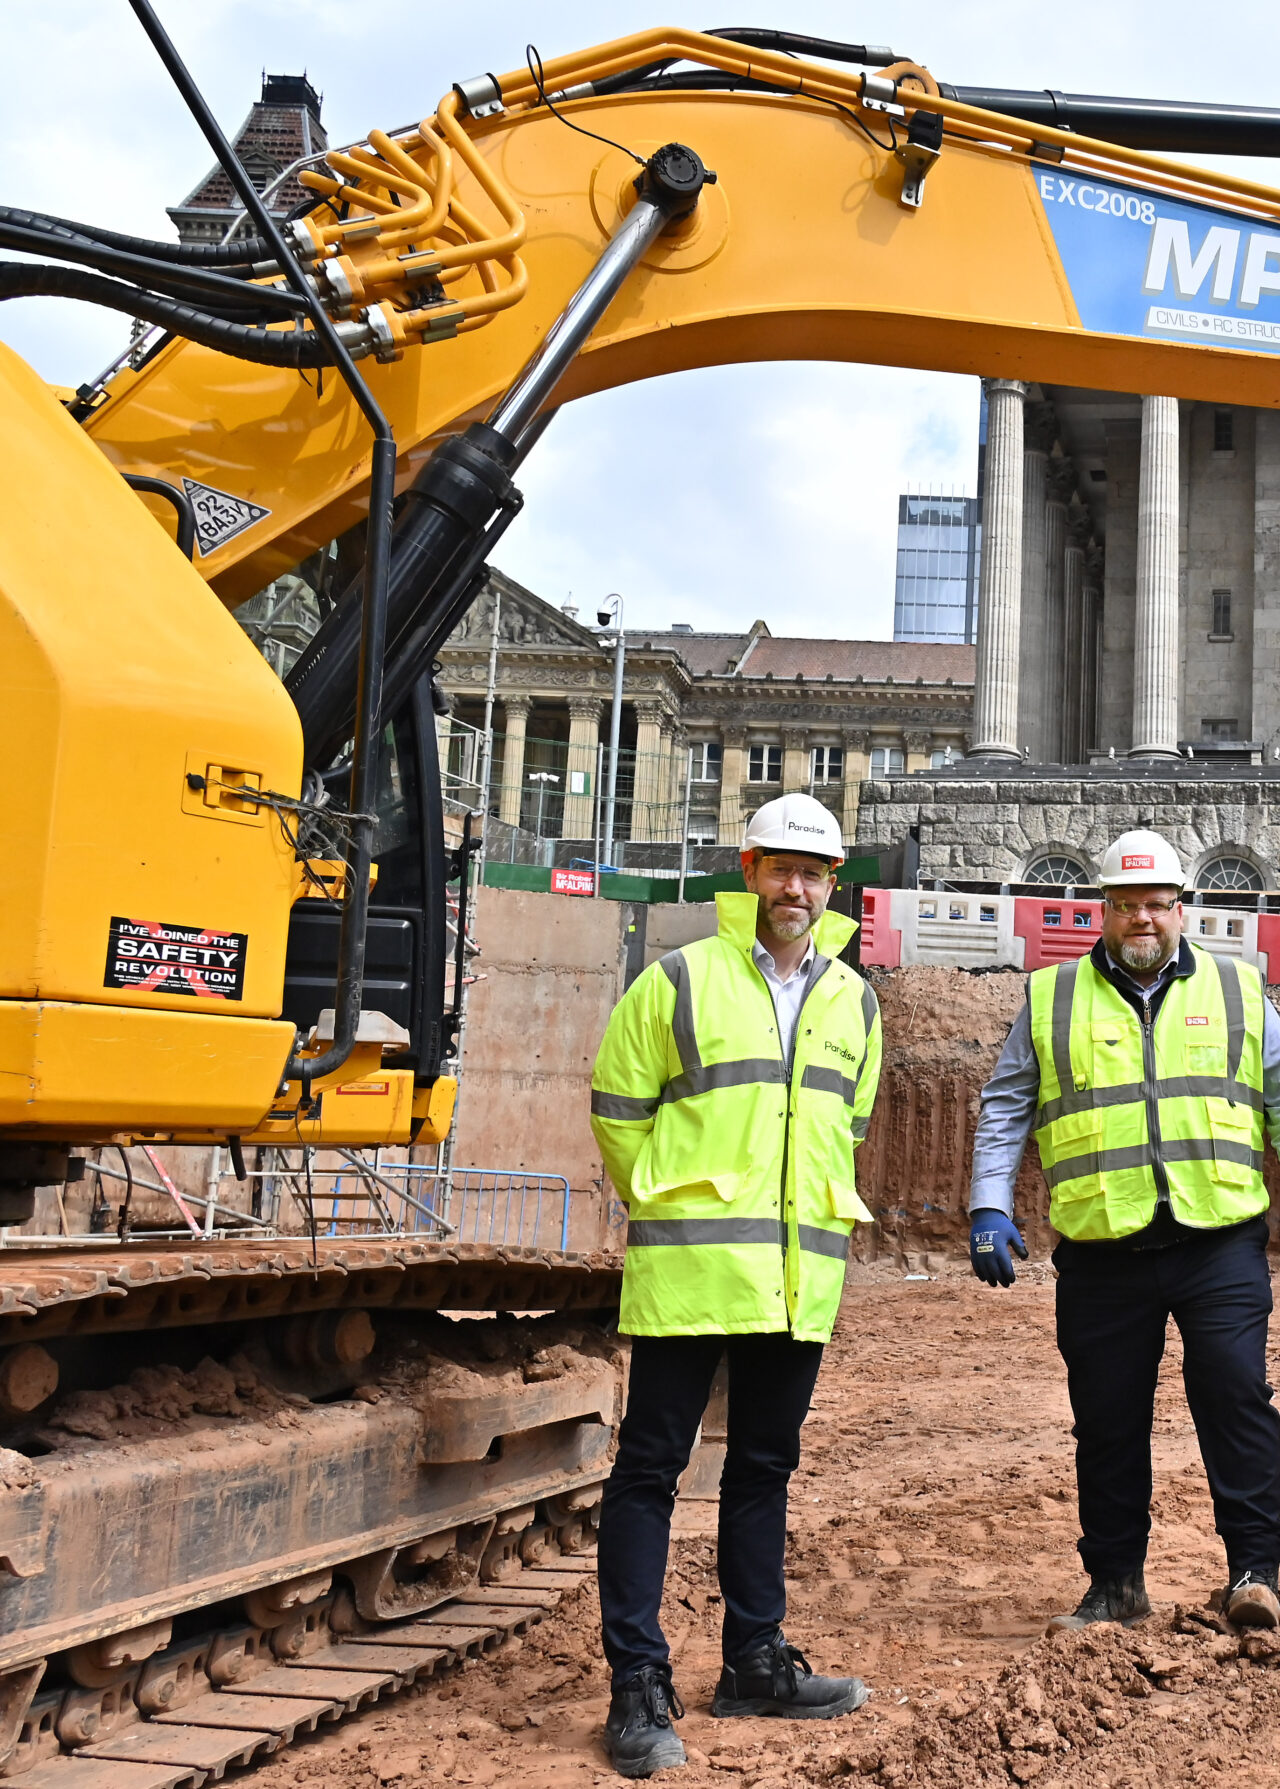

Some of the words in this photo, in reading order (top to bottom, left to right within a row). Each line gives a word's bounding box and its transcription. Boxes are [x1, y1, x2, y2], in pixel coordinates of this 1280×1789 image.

[1040, 174, 1156, 225] EXC2008
[1156, 310, 1199, 329] CIVILS
[1213, 317, 1233, 333] RC
[197, 494, 225, 517] 92
[199, 502, 246, 538] BA3Y
[788, 821, 826, 835] Paradise
[119, 924, 149, 936] I'VE
[152, 929, 209, 944] JOINED
[211, 936, 240, 948] THE
[117, 939, 239, 968] SAFETY
[115, 961, 237, 984] REVOLUTION
[824, 1040, 856, 1063] Pardise
